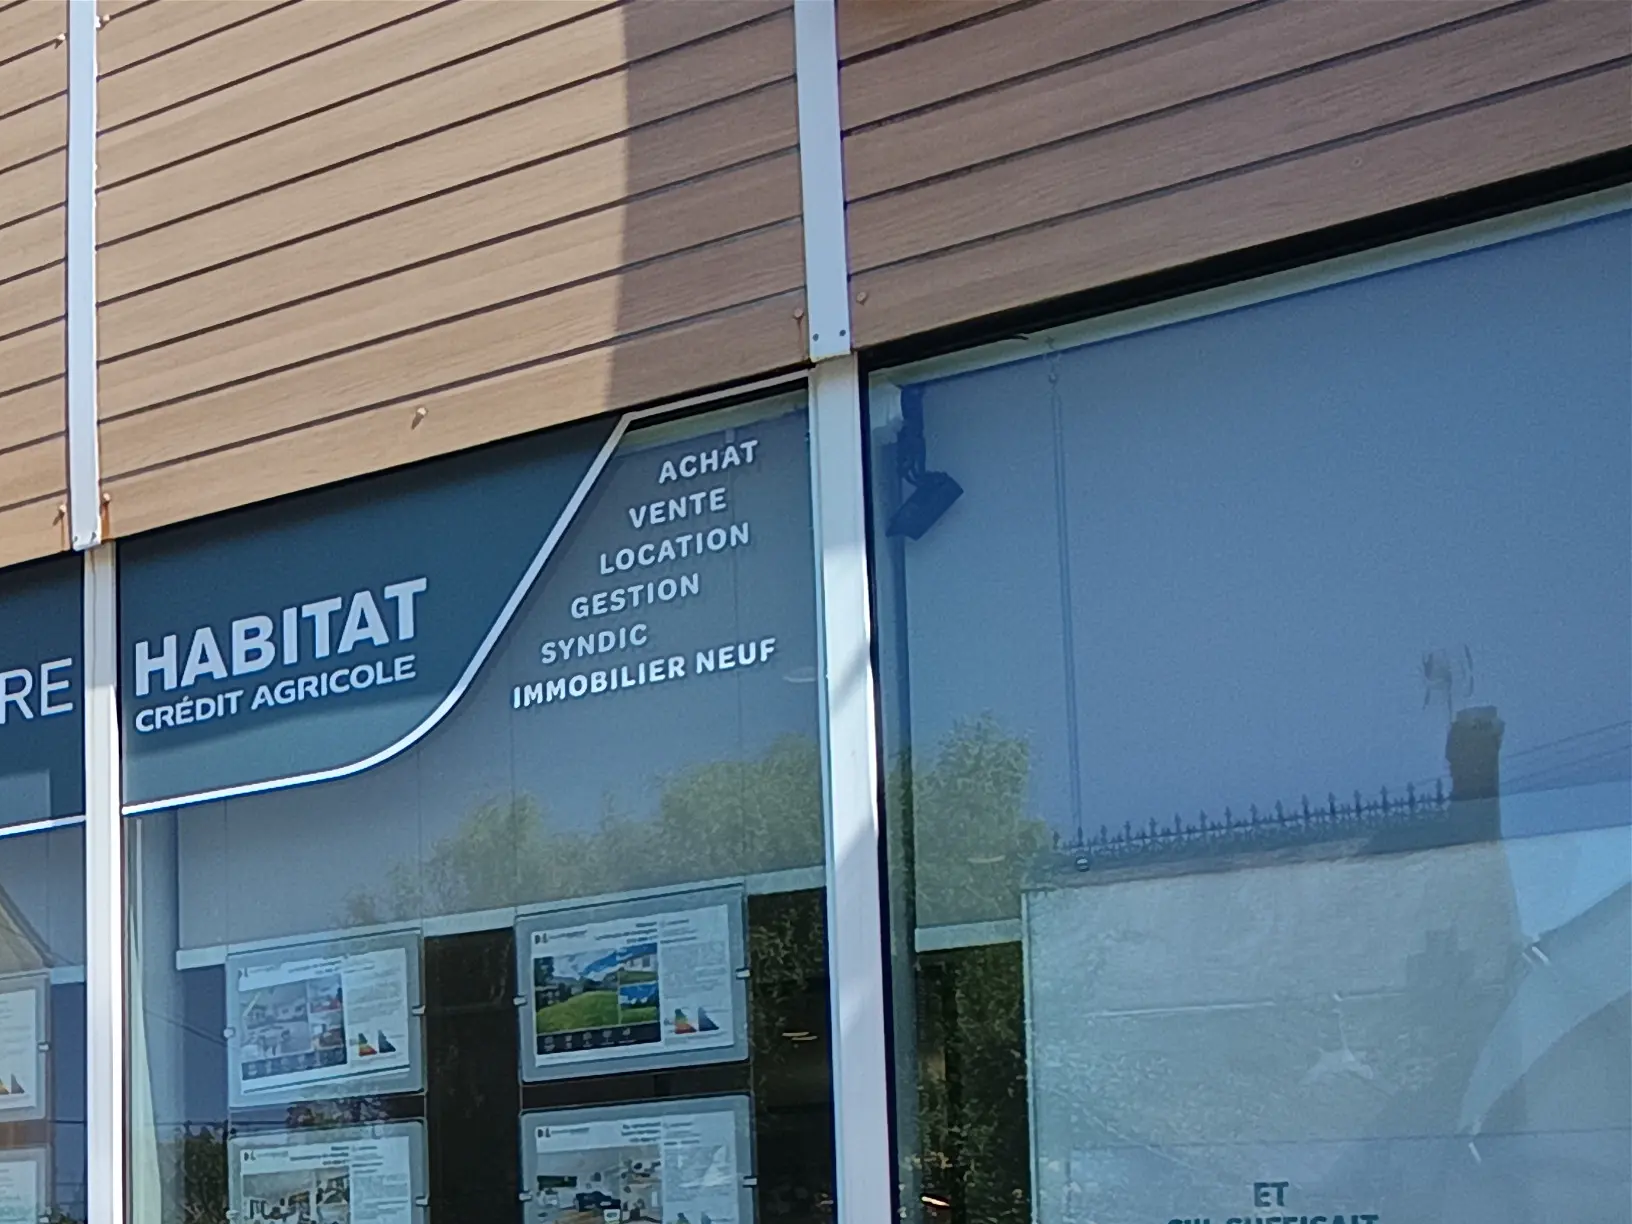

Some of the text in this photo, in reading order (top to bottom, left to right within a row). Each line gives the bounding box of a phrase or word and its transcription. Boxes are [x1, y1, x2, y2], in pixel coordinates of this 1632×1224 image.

[658, 439, 758, 484] ACHAT
[629, 487, 727, 529] VENTE
[599, 522, 750, 575] LOCATION
[571, 573, 700, 619] GESTION
[134, 576, 428, 697] HABITAT
[541, 623, 648, 664] SYNDIC
[134, 653, 417, 734] CRÉDIT AGRICOLE
[513, 637, 777, 709] IMMOBILIER NEUF
[1253, 1181, 1290, 1208] ET
